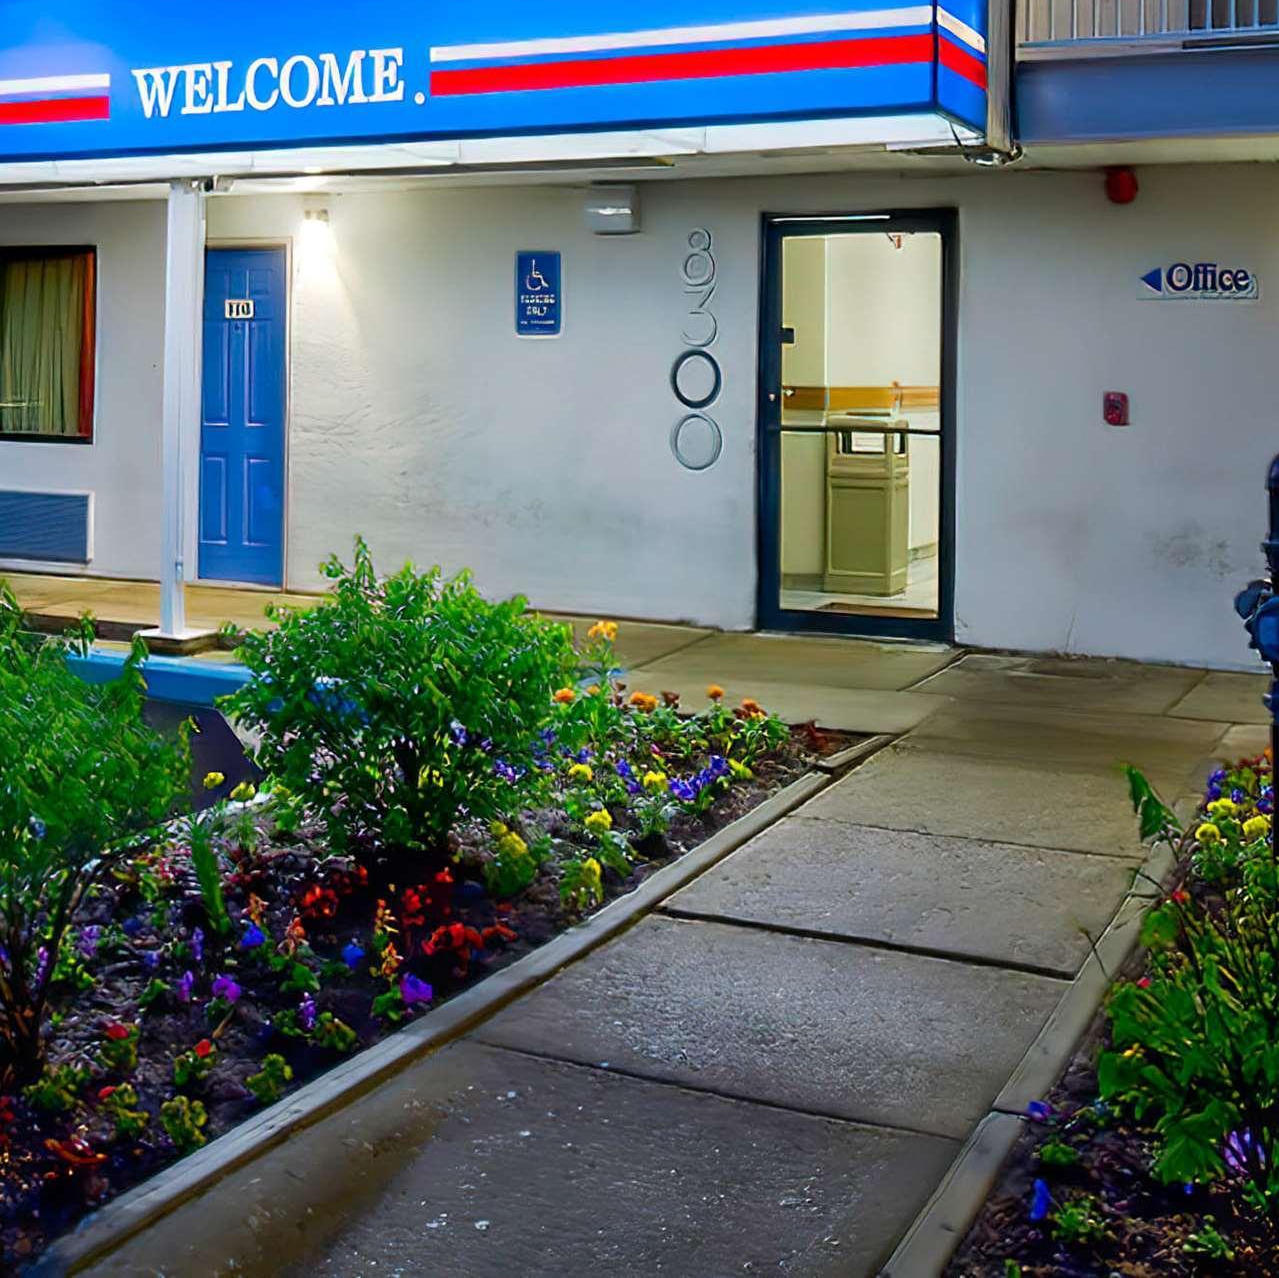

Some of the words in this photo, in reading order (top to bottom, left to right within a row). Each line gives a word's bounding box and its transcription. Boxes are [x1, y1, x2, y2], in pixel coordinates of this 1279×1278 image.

[131, 47, 426, 119] WELCOME.
[1166, 262, 1250, 292] Office
[227, 301, 252, 317] 110
